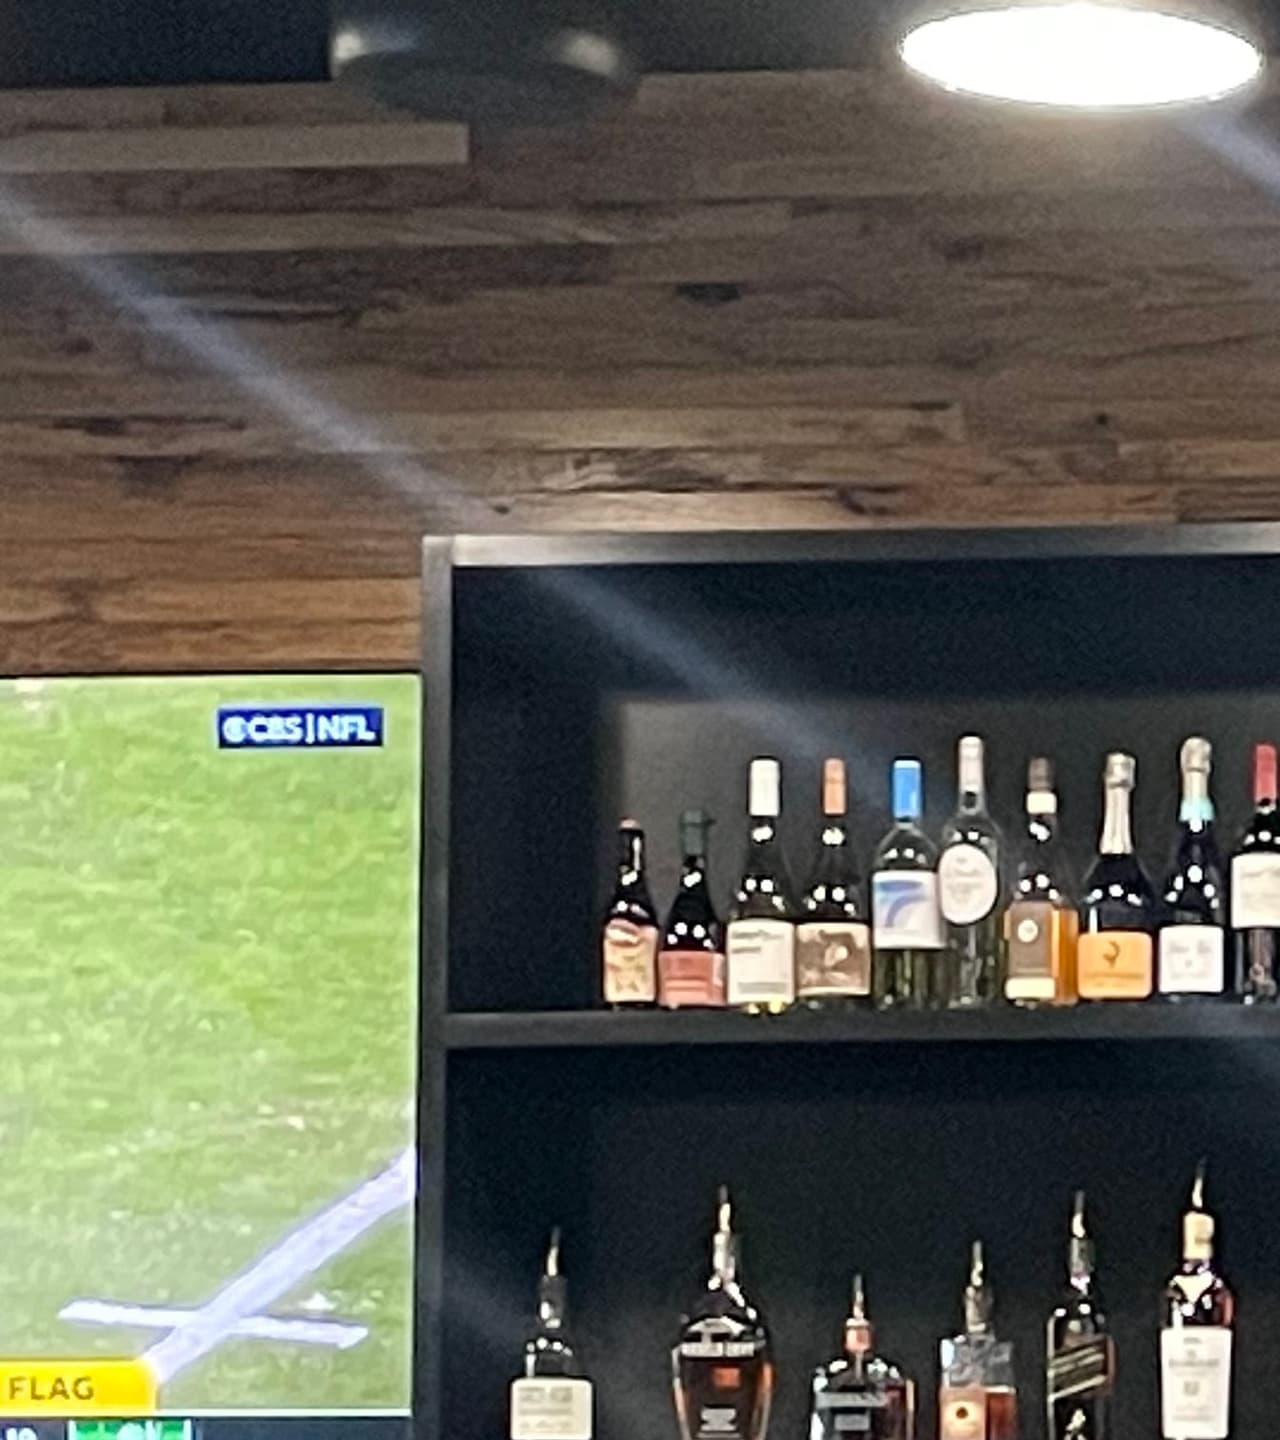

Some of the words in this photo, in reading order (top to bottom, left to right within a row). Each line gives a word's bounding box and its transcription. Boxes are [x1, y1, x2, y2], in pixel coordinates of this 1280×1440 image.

[250, 715, 303, 742] CBS
[317, 714, 376, 742] NFL
[7, 1375, 95, 1401] FLAG
